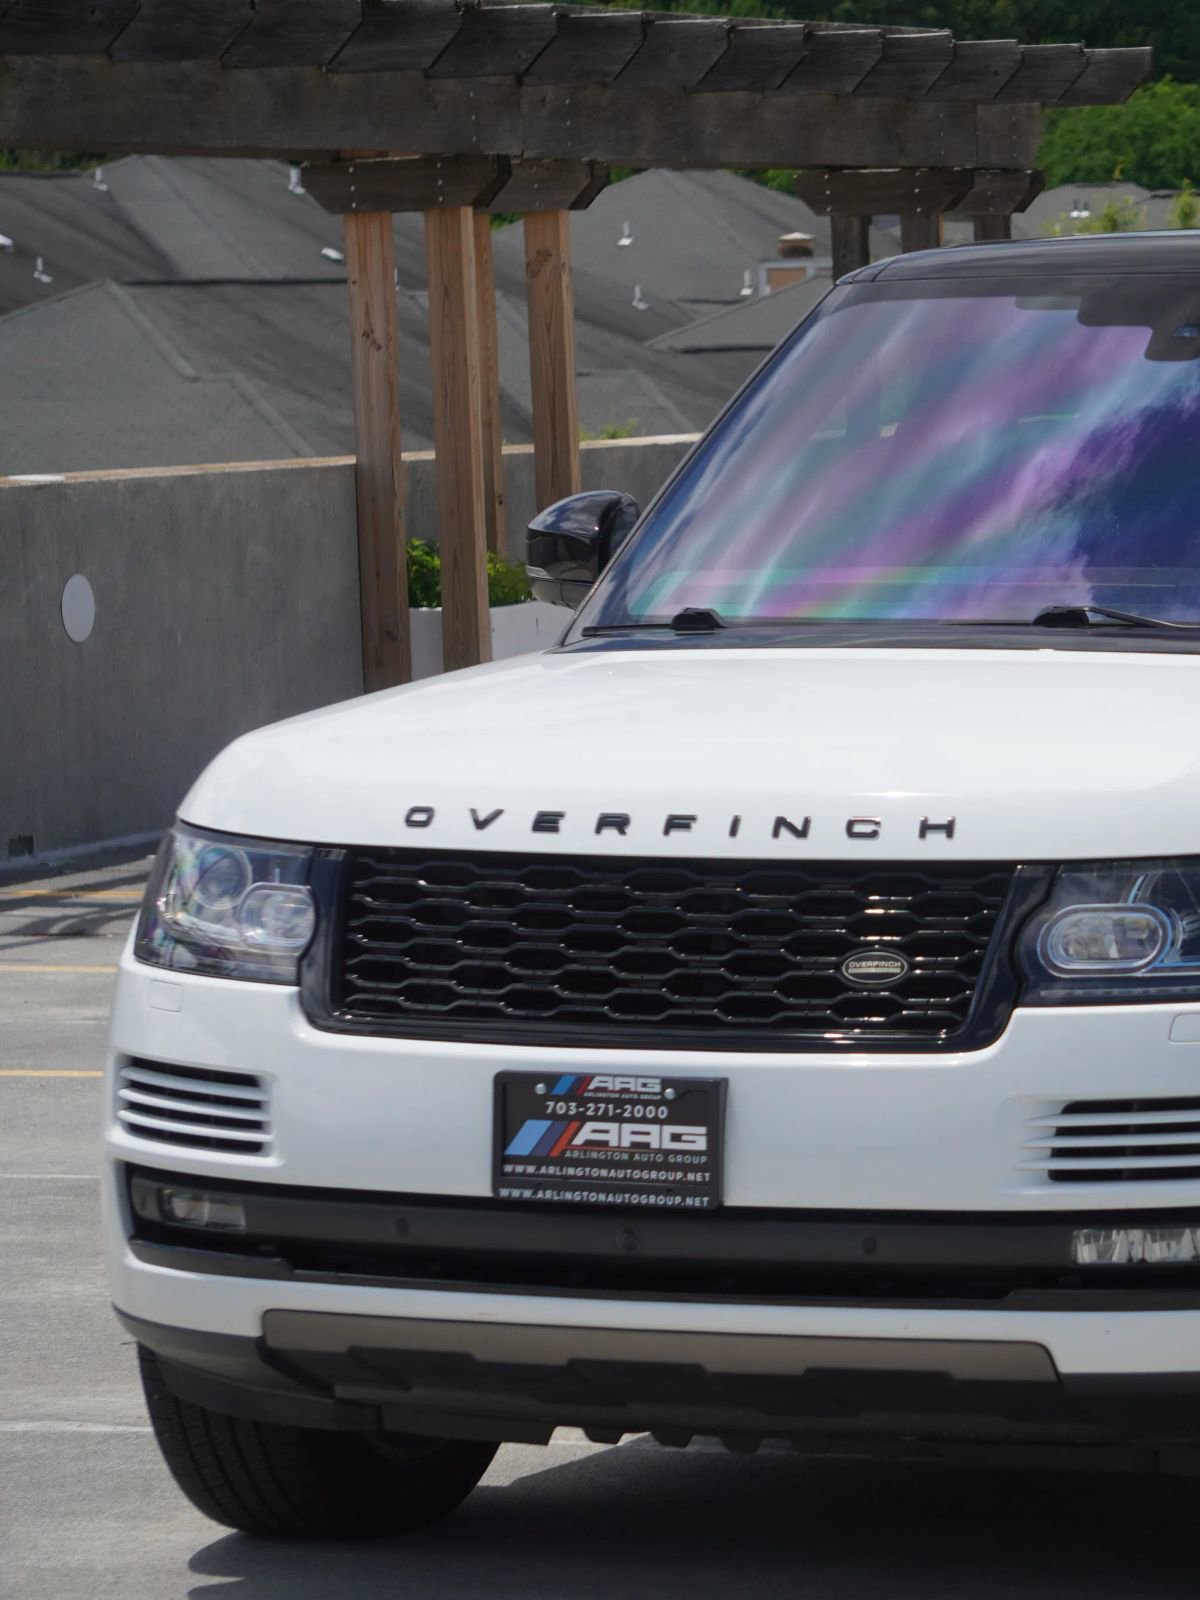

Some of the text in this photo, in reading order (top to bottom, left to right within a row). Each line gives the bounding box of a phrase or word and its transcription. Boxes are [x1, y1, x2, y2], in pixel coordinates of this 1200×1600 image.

[403, 805, 957, 840] OVERFINCH
[848, 960, 902, 969] OVERFINCH
[586, 1075, 662, 1093] AAG
[545, 1101, 669, 1119] 703-271-2000
[570, 1121, 707, 1151] AAG
[564, 1150, 708, 1165] ARLINGTON AUTO GROUP
[503, 1163, 712, 1182] WWW.ARLINGTONAUTOGROUP.NET
[498, 1187, 710, 1208] WWW.ARLINGTONAUTOGROUP.NET
